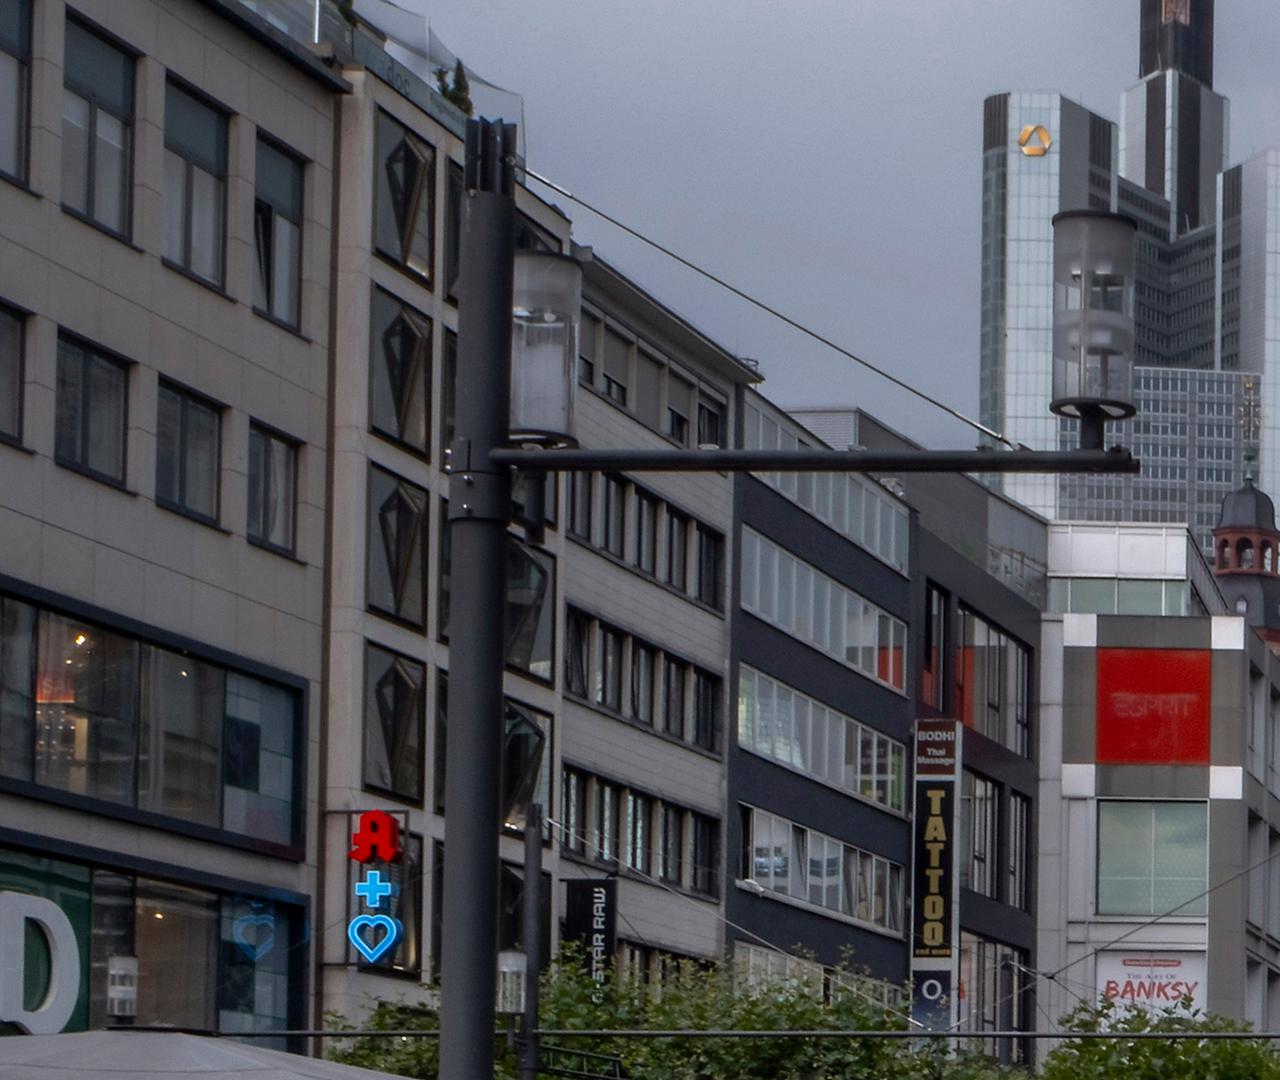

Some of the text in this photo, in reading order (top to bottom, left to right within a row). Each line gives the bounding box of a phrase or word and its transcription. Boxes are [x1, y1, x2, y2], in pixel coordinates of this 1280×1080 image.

[918, 731, 955, 741] BODHI
[923, 789, 947, 947] TATTOO
[592, 887, 606, 930] RAW
[1104, 979, 1199, 1001] BANKSY
